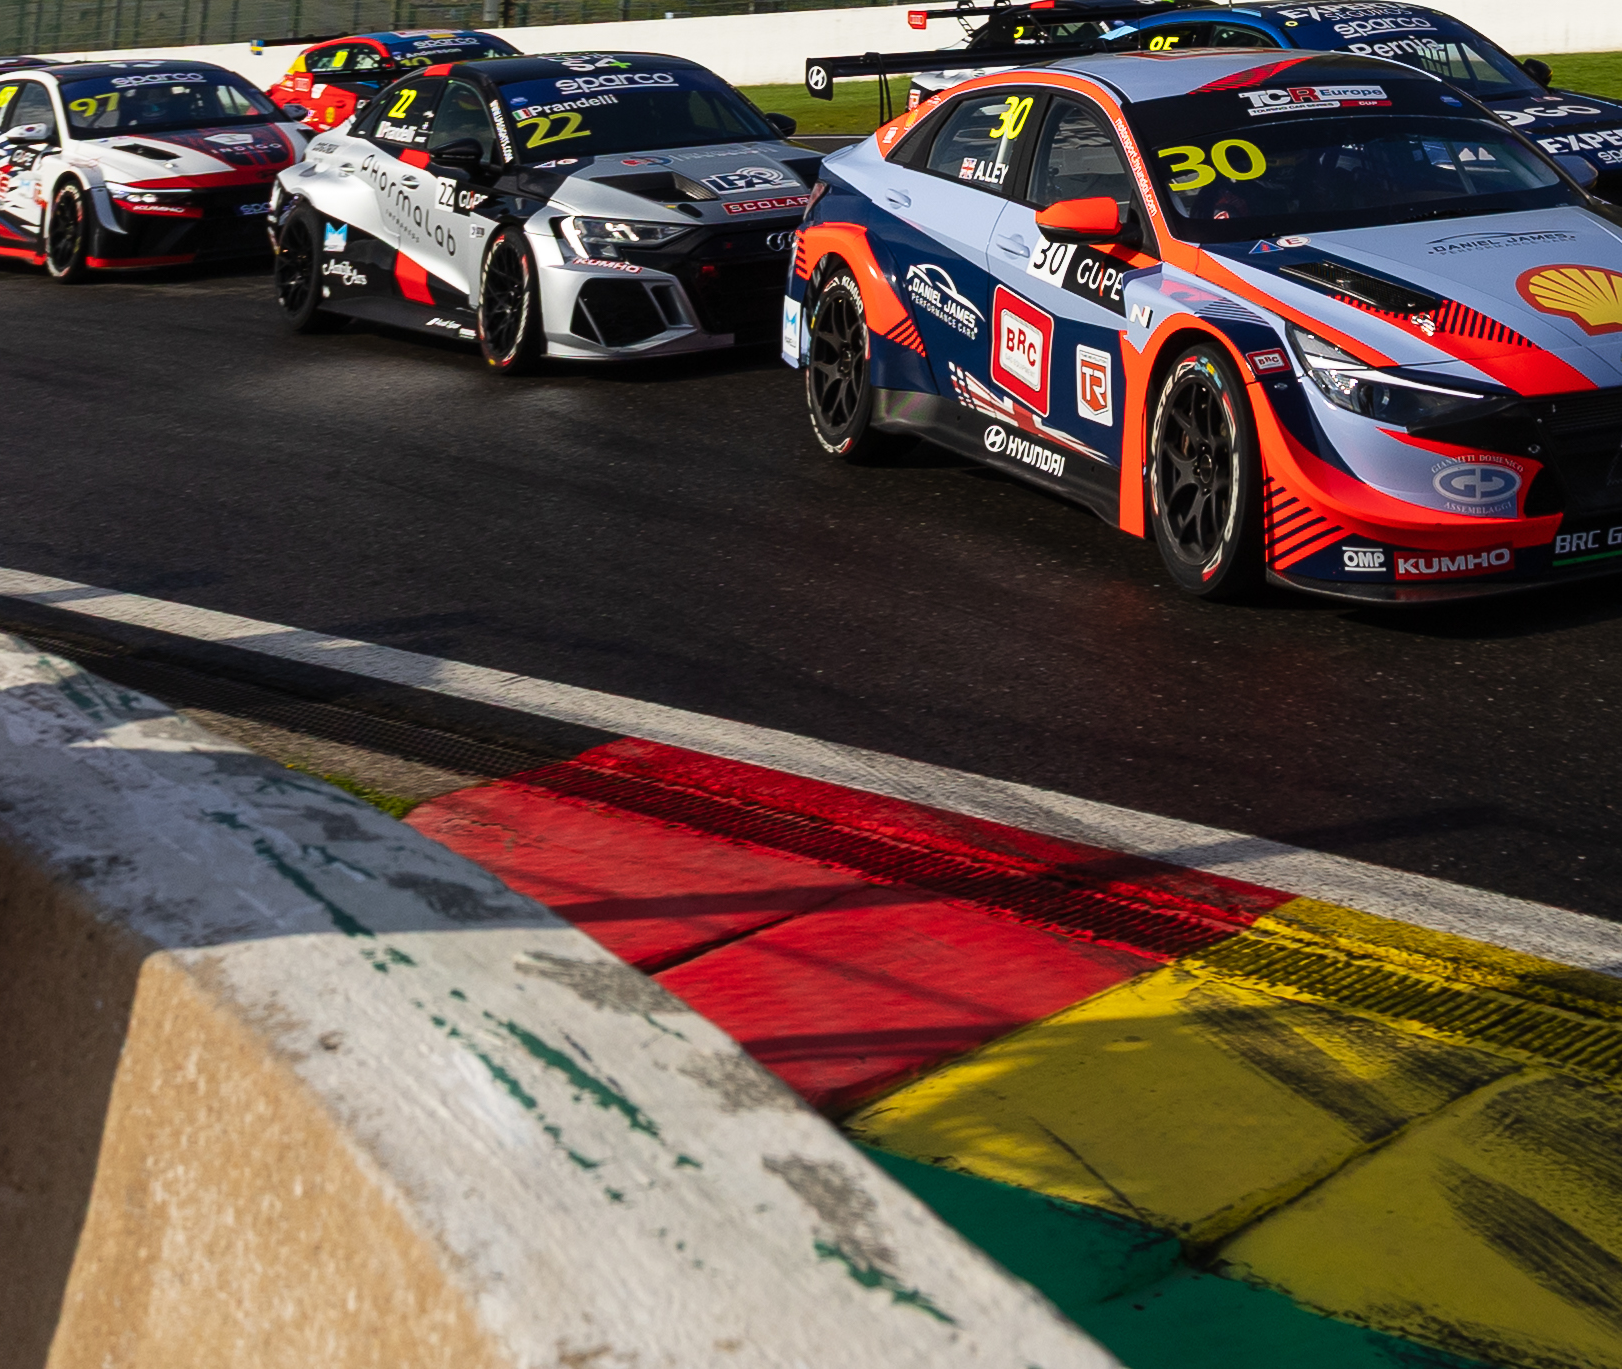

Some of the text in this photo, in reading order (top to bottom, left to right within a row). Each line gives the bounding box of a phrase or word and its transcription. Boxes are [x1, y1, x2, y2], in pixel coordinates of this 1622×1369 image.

[1334, 17, 1431, 41] sparco
[111, 73, 204, 88] sparco
[555, 73, 674, 93] sparco
[69, 92, 119, 117] 97
[388, 89, 417, 119] 22
[528, 94, 619, 117] Prandelli
[1238, 87, 1383, 108] TCR Europe
[990, 96, 1034, 139] 30
[516, 112, 591, 149] 22
[1158, 139, 1267, 191] 30
[439, 182, 455, 208] 22
[1433, 233, 1567, 253] DANIEL JAMES
[576, 258, 639, 274] KUMHO
[1033, 243, 1069, 276] 30
[841, 275, 864, 315] KUMHO
[912, 277, 976, 329] DANIEL JAMES
[911, 293, 976, 341] PERFORMANCE CARS
[1006, 326, 1037, 368] BRC
[1257, 355, 1280, 366] BRC
[1082, 366, 1106, 407] TR
[1006, 435, 1066, 477] HYUNDAI
[1479, 454, 1524, 473] DOMENICO
[1444, 500, 1512, 515] ASSEMBLAGGI
[1555, 530, 1601, 554] BRC
[1343, 550, 1385, 568] OMP
[1398, 548, 1510, 574] KUMHO
